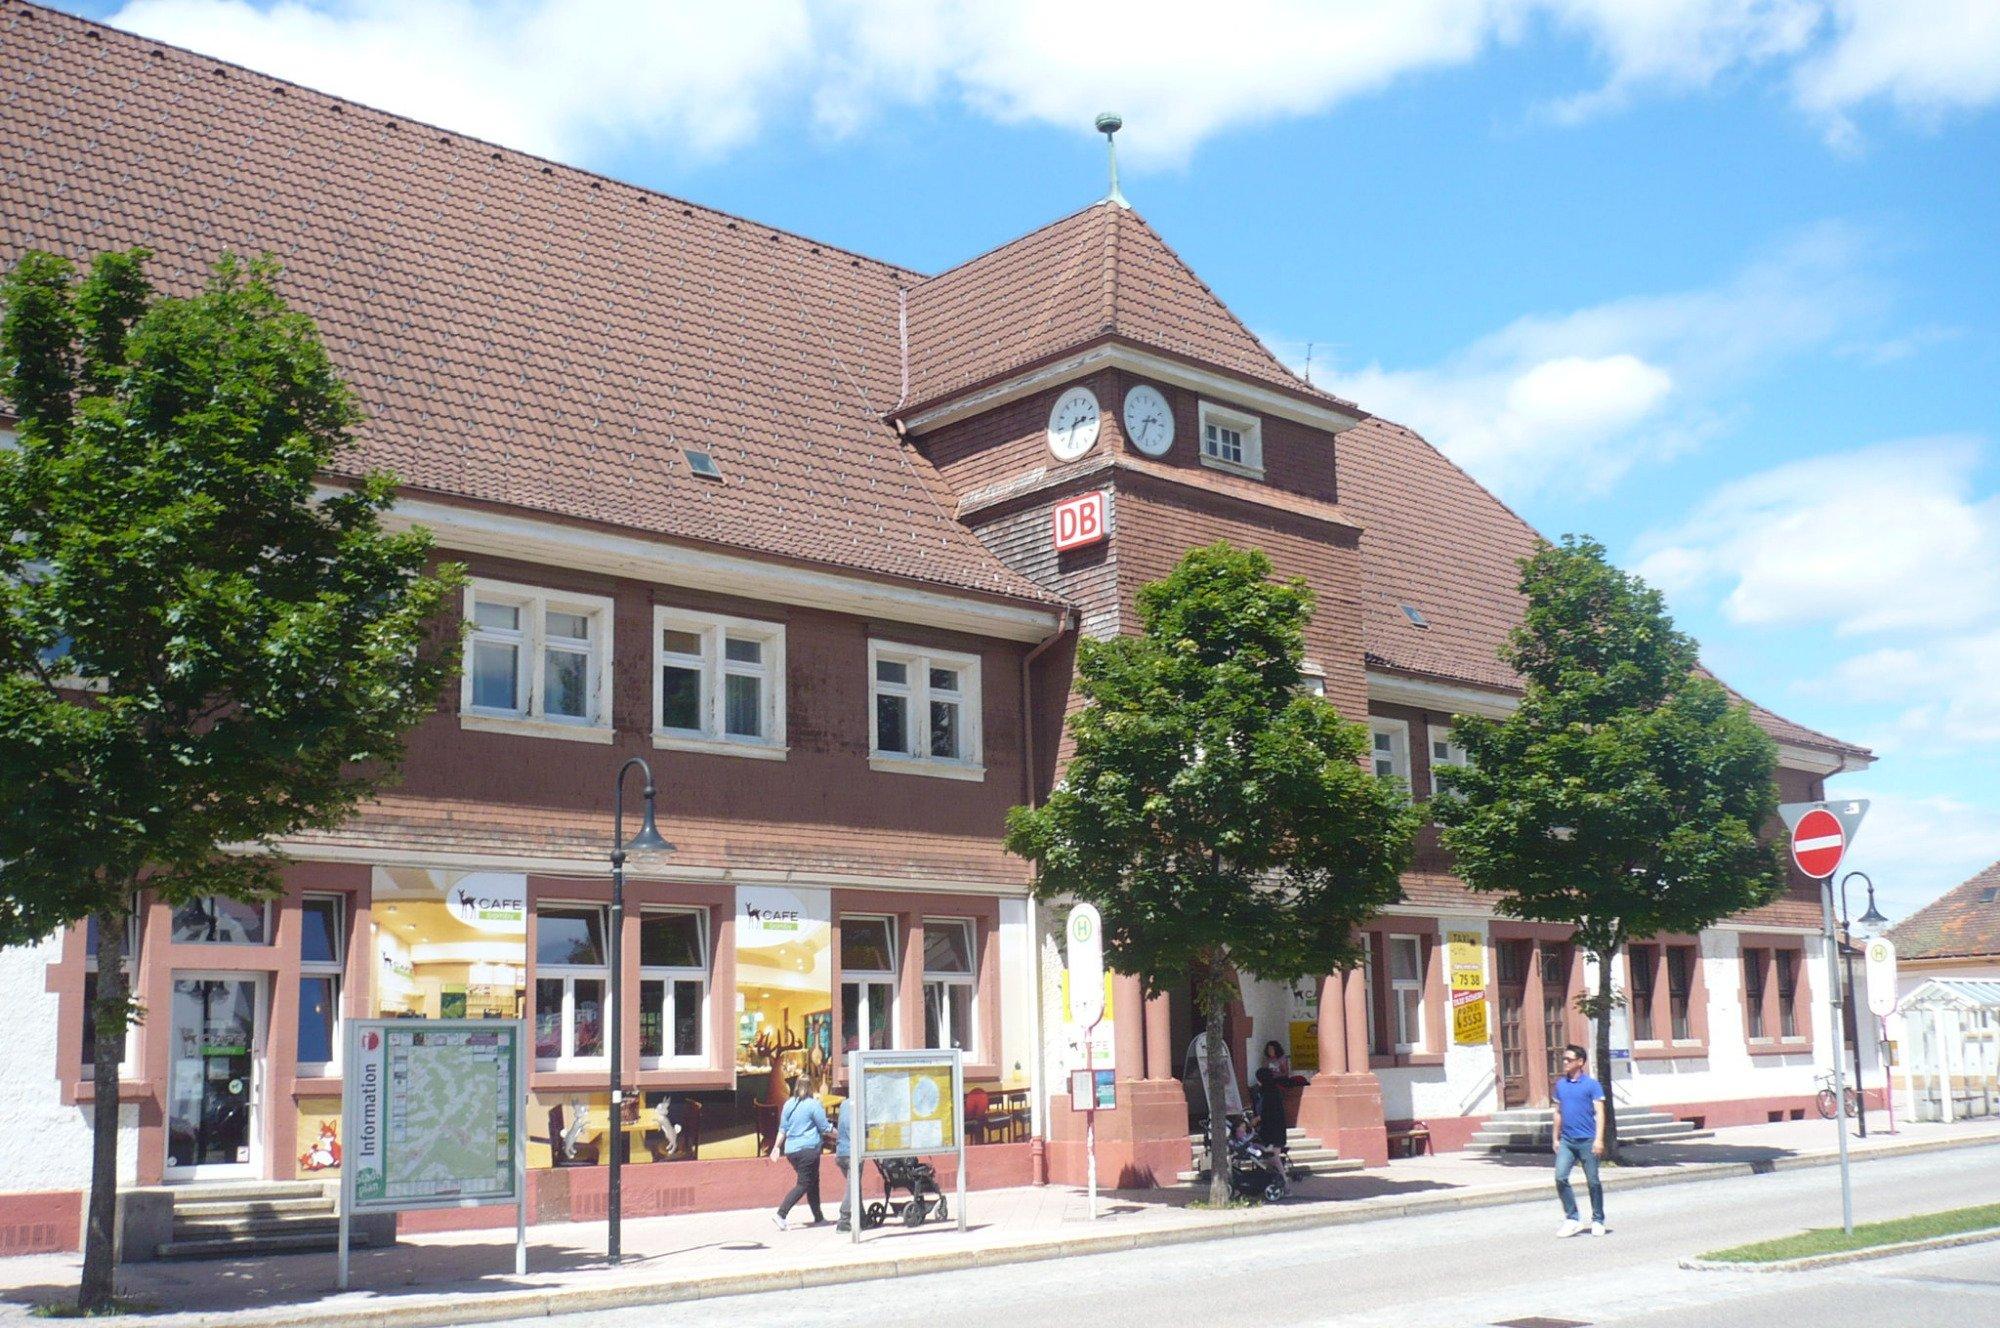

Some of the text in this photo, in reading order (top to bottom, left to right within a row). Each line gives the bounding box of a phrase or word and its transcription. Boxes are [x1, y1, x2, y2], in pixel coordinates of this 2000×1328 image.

[1060, 502, 1097, 541] DB
[478, 898, 523, 910] CAFE
[762, 909, 799, 921] CAFE
[1459, 973, 1468, 985] 75
[359, 1063, 377, 1156] Information
